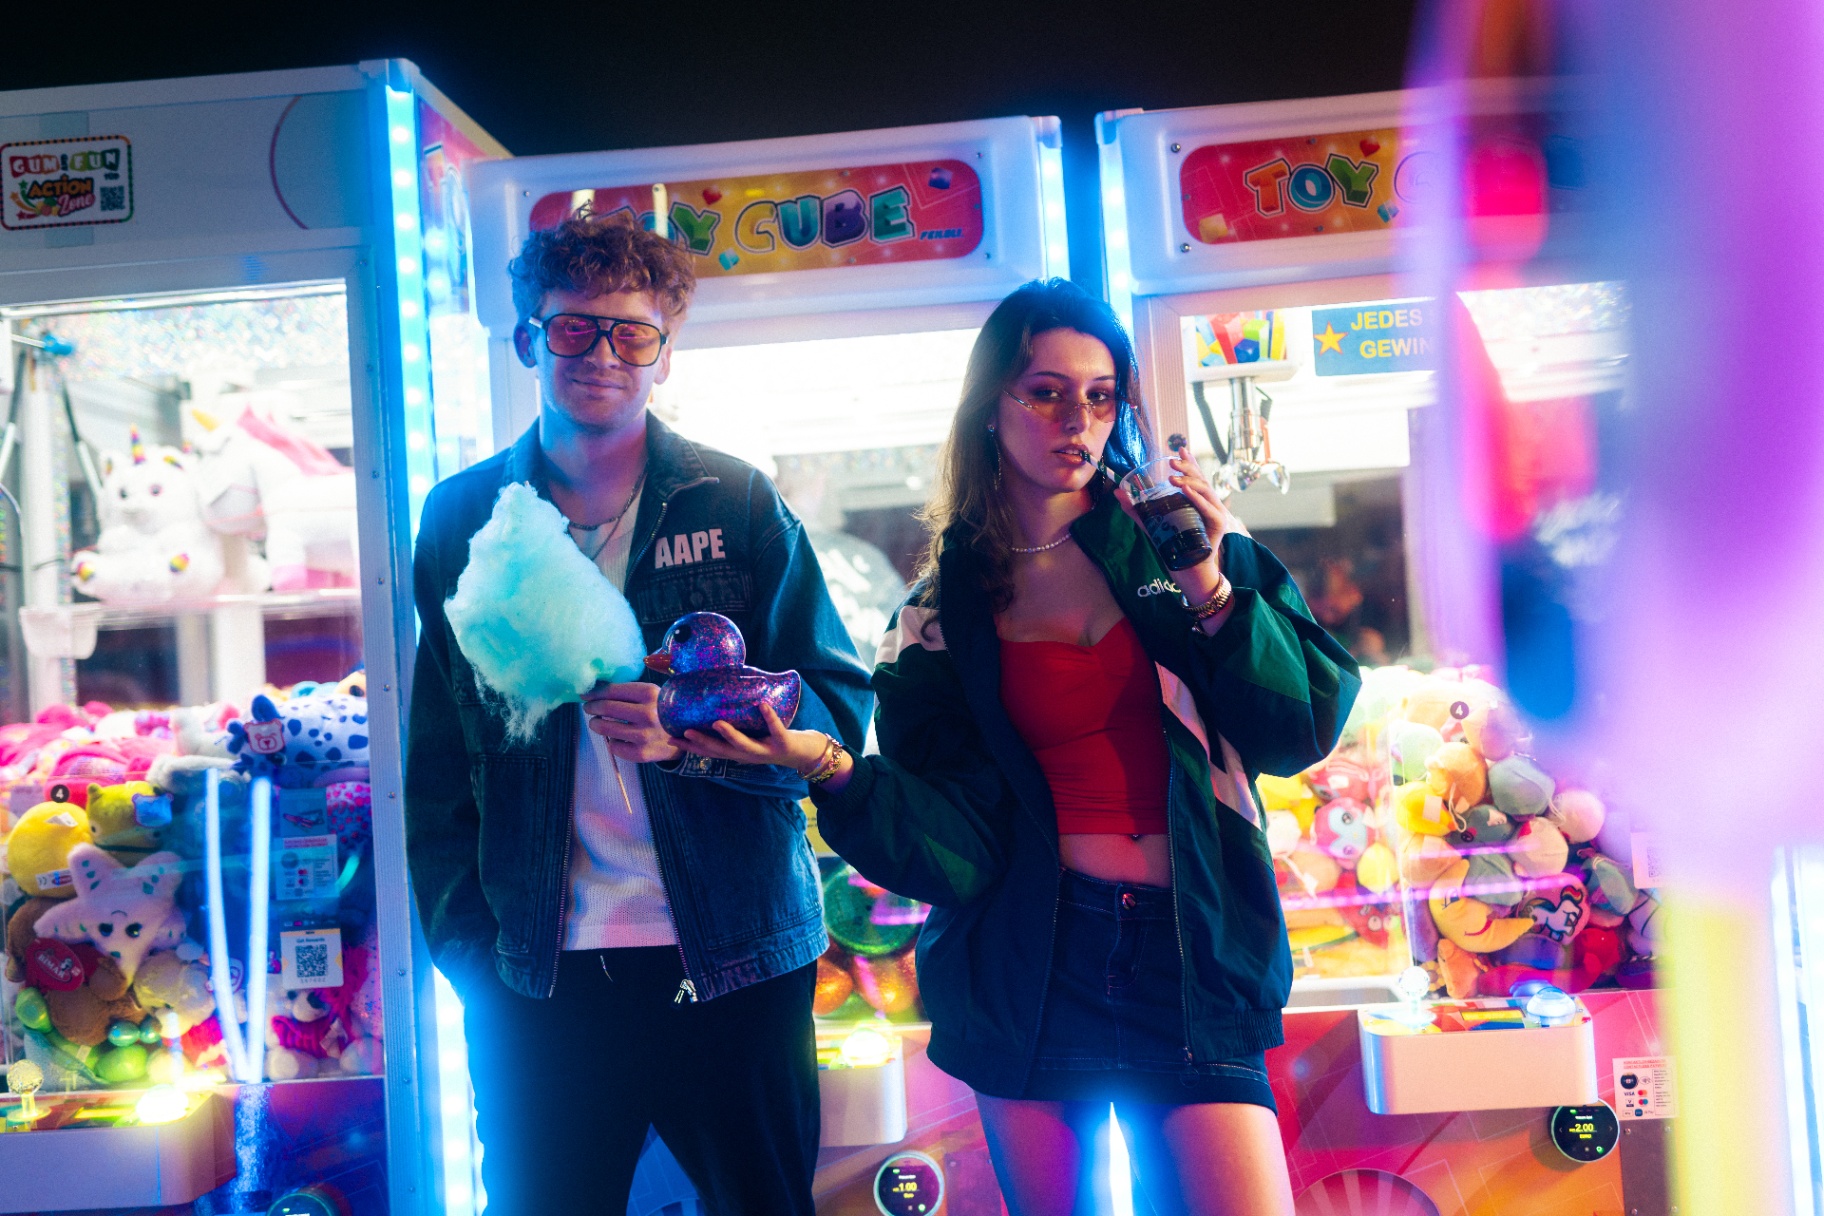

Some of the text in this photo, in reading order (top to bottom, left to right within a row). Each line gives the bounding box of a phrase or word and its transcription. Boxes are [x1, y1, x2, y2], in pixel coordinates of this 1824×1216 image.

[10, 154, 59, 177] GUM
[70, 149, 120, 172] FUN
[28, 174, 94, 199] ACTION
[1243, 153, 1379, 218] TOY
[58, 194, 95, 217] Zone
[735, 184, 915, 255] CUBE
[1350, 308, 1423, 331] JEDES
[655, 528, 726, 569] AAPE
[1455, 704, 1463, 716] 4
[55, 788, 64, 800] 4
